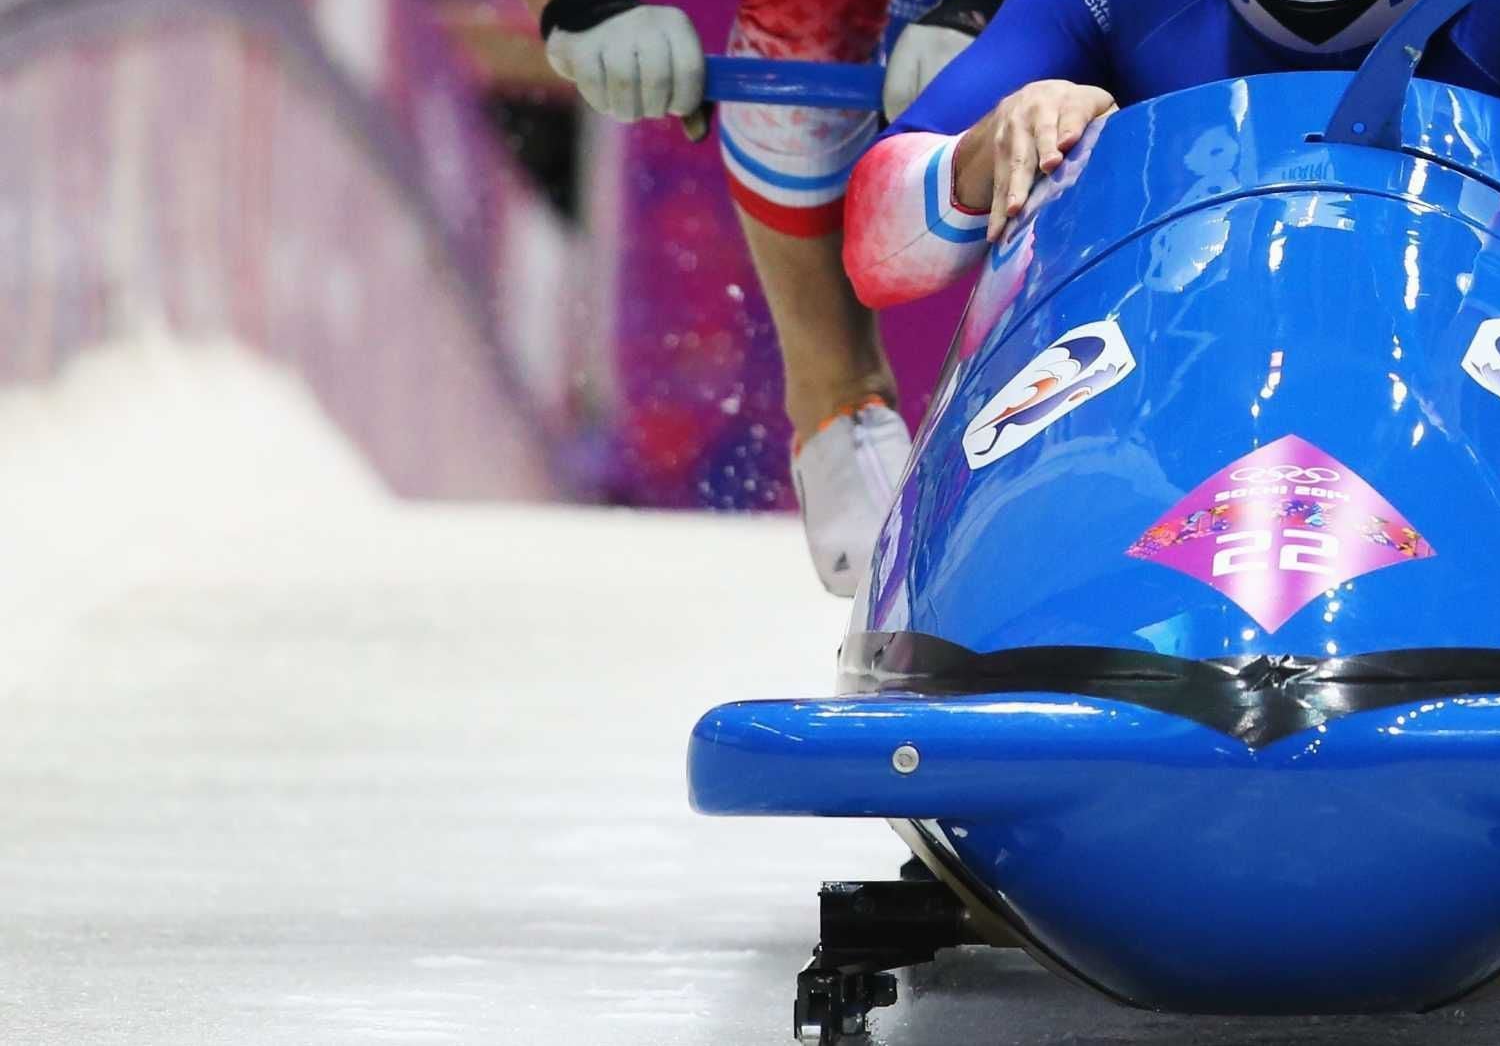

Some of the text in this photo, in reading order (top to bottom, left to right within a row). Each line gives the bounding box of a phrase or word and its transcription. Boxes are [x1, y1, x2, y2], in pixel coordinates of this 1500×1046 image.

[1214, 486, 1350, 502] SOCHI 2014
[1212, 529, 1340, 577] 22
